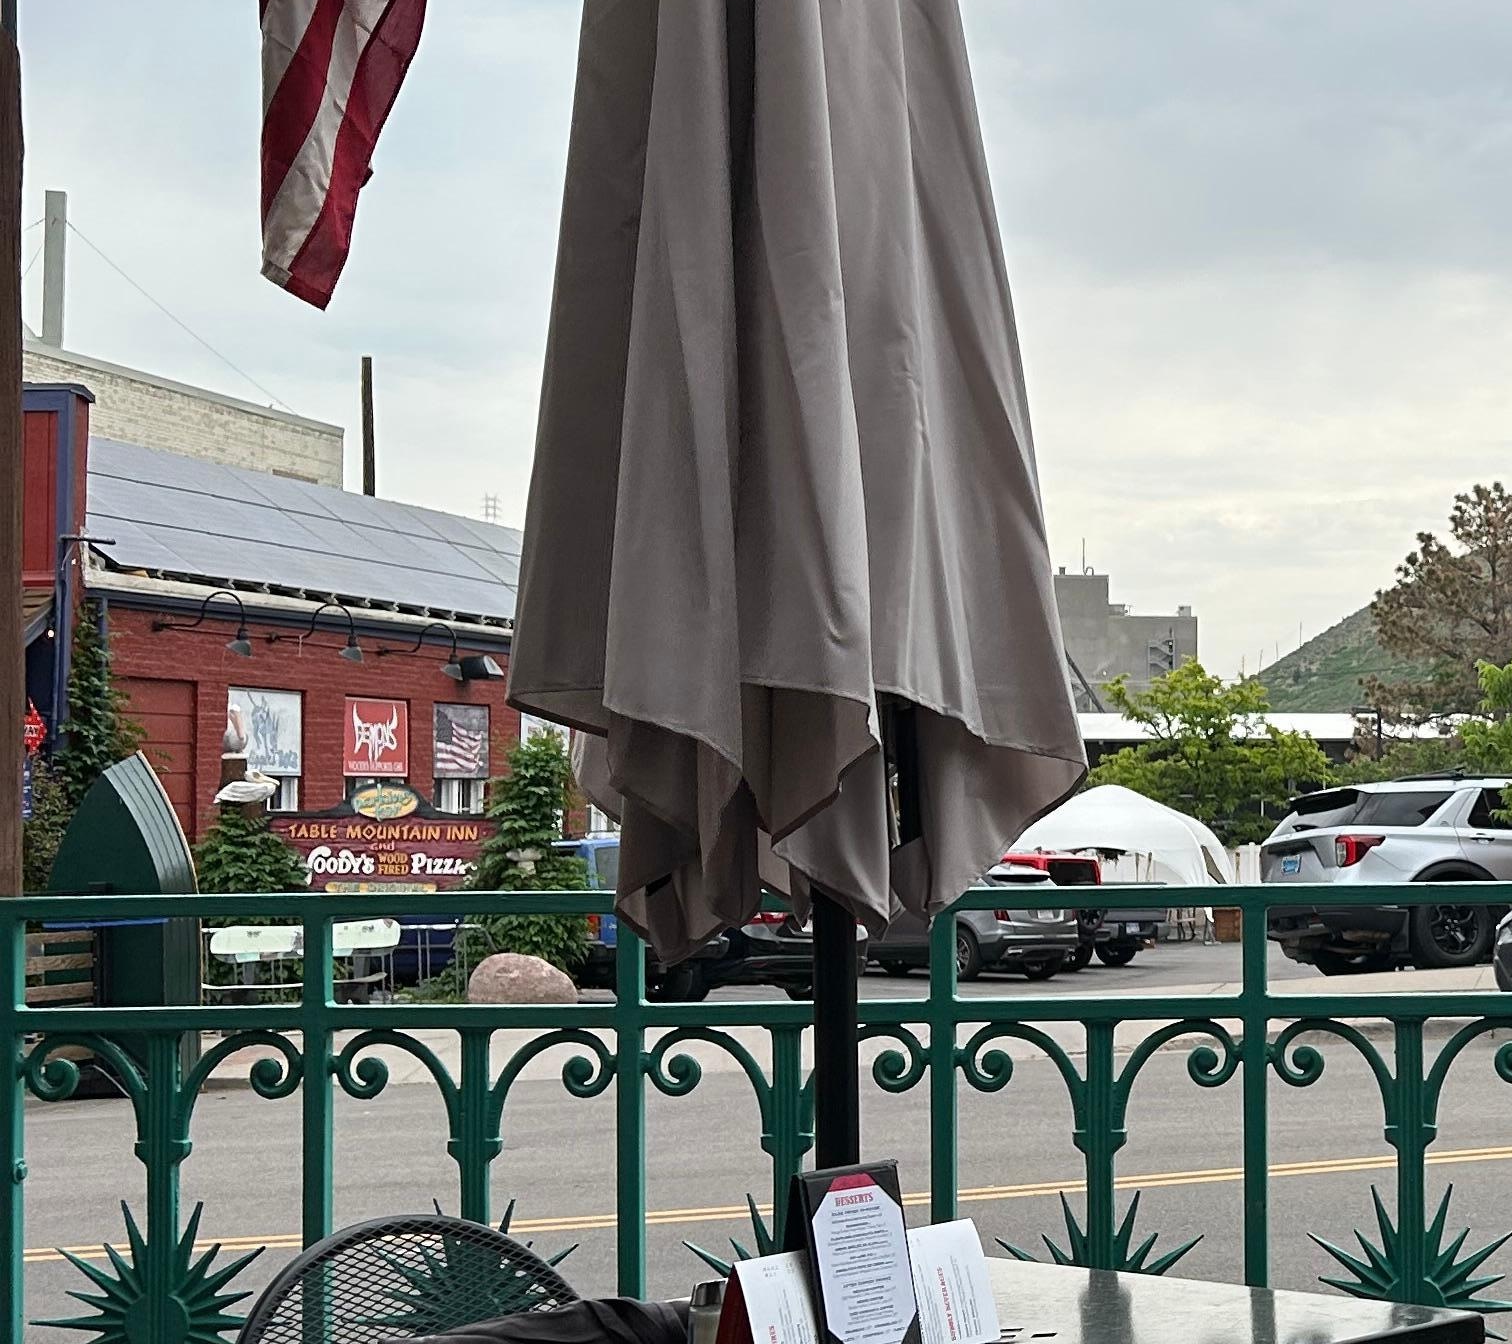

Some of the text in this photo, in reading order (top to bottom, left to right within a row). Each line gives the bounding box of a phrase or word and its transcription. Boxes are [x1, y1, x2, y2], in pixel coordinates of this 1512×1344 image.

[353, 702, 398, 763] DEMONS
[289, 823, 478, 841] TABLE MOUNTAIN INN
[370, 841, 395, 851] and
[378, 853, 409, 864] WOOD
[378, 864, 409, 875] FIRED
[835, 1192, 874, 1207] DESSERTS
